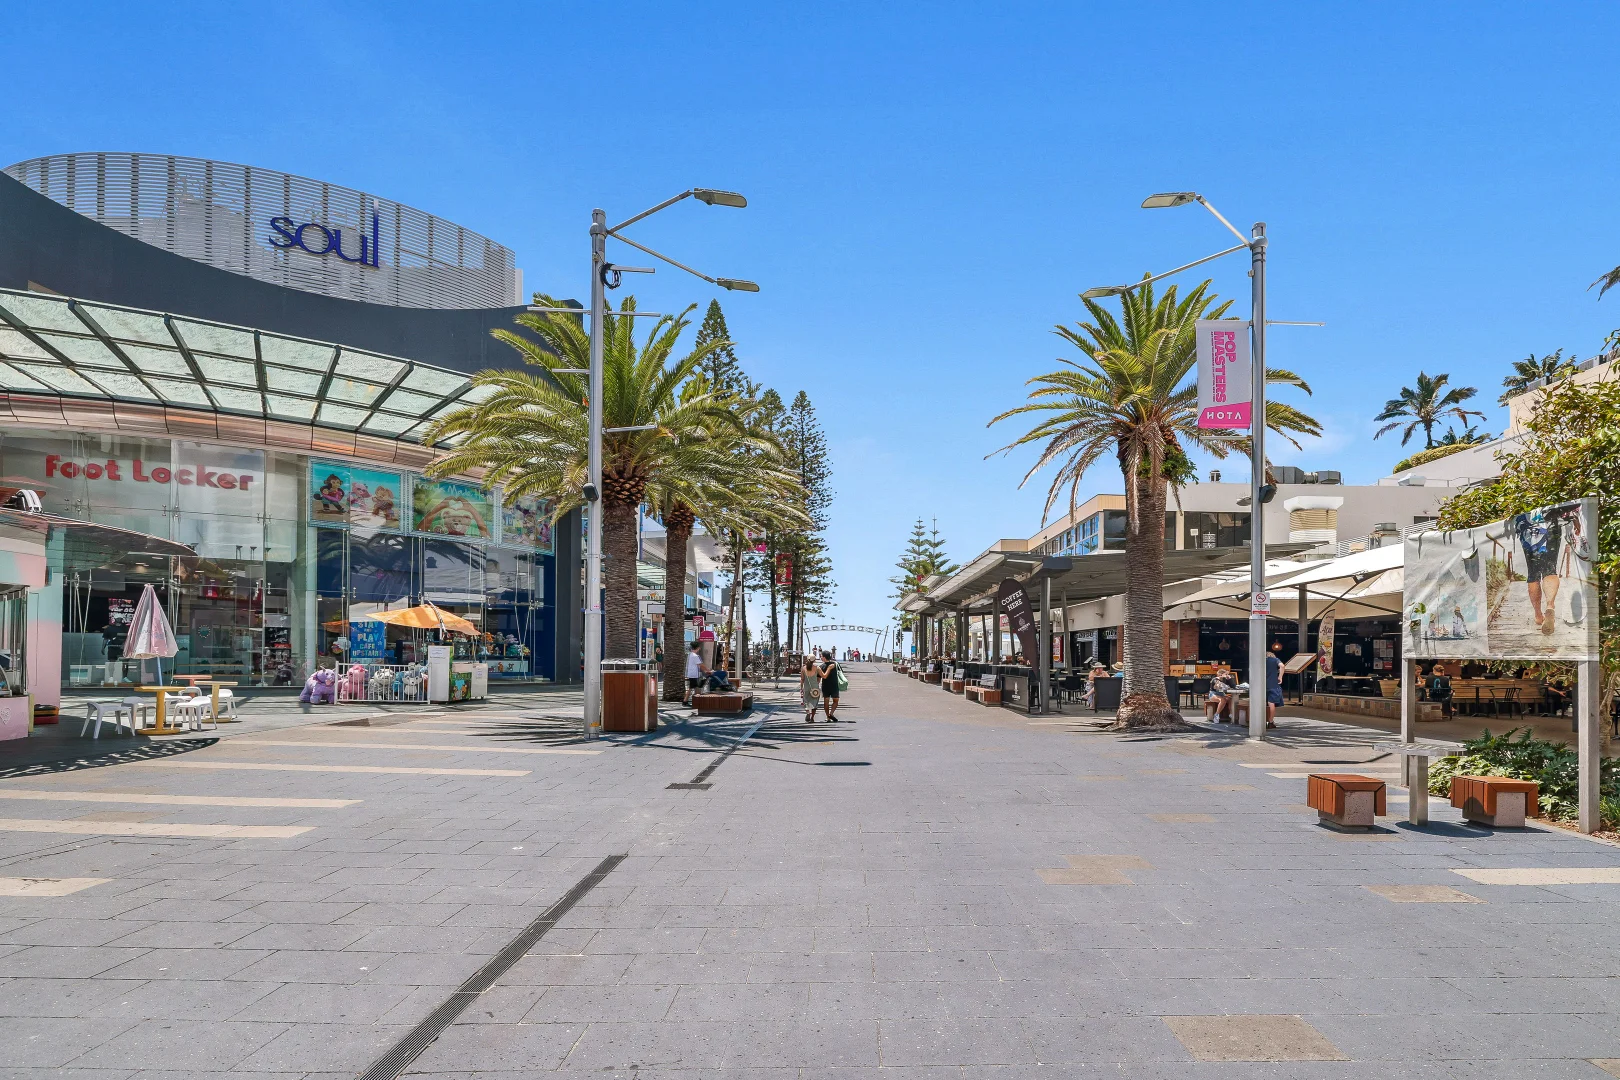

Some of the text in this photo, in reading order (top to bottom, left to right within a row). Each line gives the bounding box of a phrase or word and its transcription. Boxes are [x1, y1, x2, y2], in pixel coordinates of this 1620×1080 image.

[268, 199, 379, 268] soul
[1225, 331, 1236, 362] POP
[1214, 331, 1226, 402] MASTERS
[132, 459, 254, 491] Locker
[1001, 589, 1023, 606] COFFEE
[1007, 598, 1023, 611] HERE
[357, 633, 379, 642] PLAY
